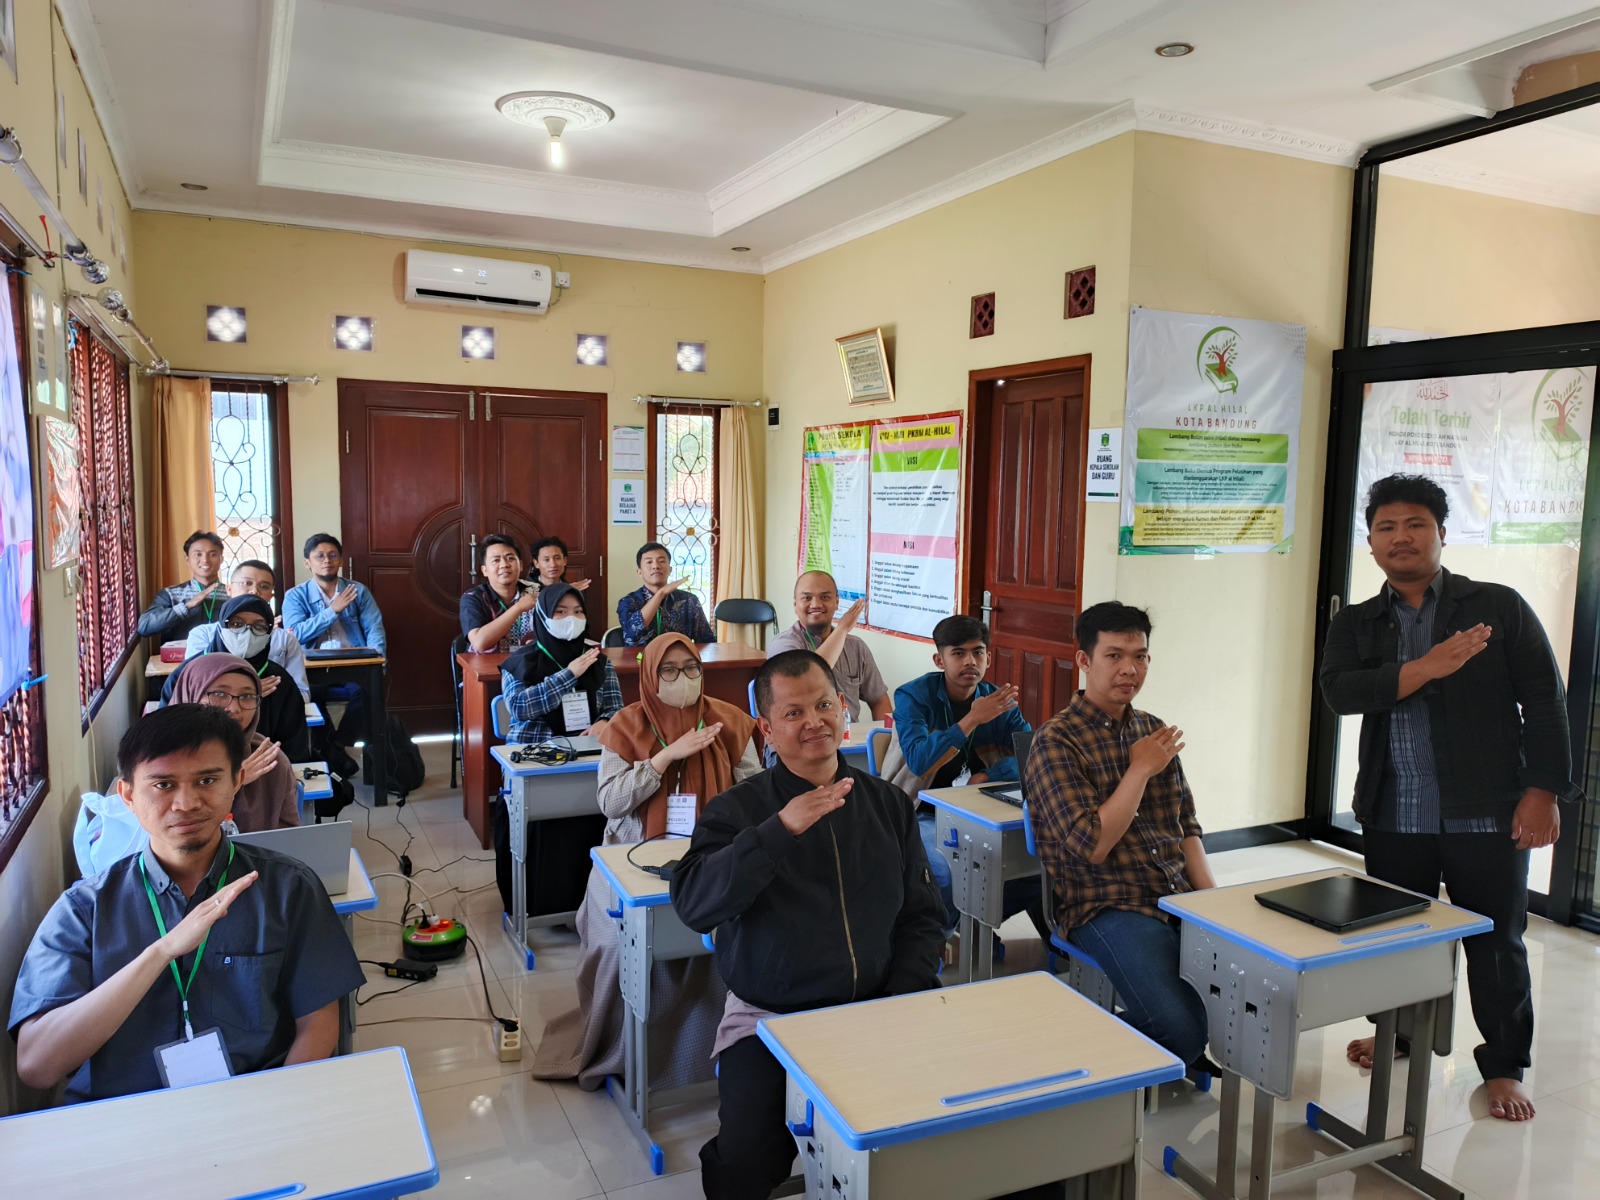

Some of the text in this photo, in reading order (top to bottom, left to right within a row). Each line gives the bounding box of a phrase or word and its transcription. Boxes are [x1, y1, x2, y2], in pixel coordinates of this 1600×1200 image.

[1188, 403, 1248, 414] LKP AL HILAL
[1391, 406, 1428, 426] Telah
[1175, 416, 1257, 430] KOTA BANDUNG
[907, 429, 924, 438] PKBM
[907, 456, 918, 465] VISI
[1504, 499, 1536, 514] KOTA
